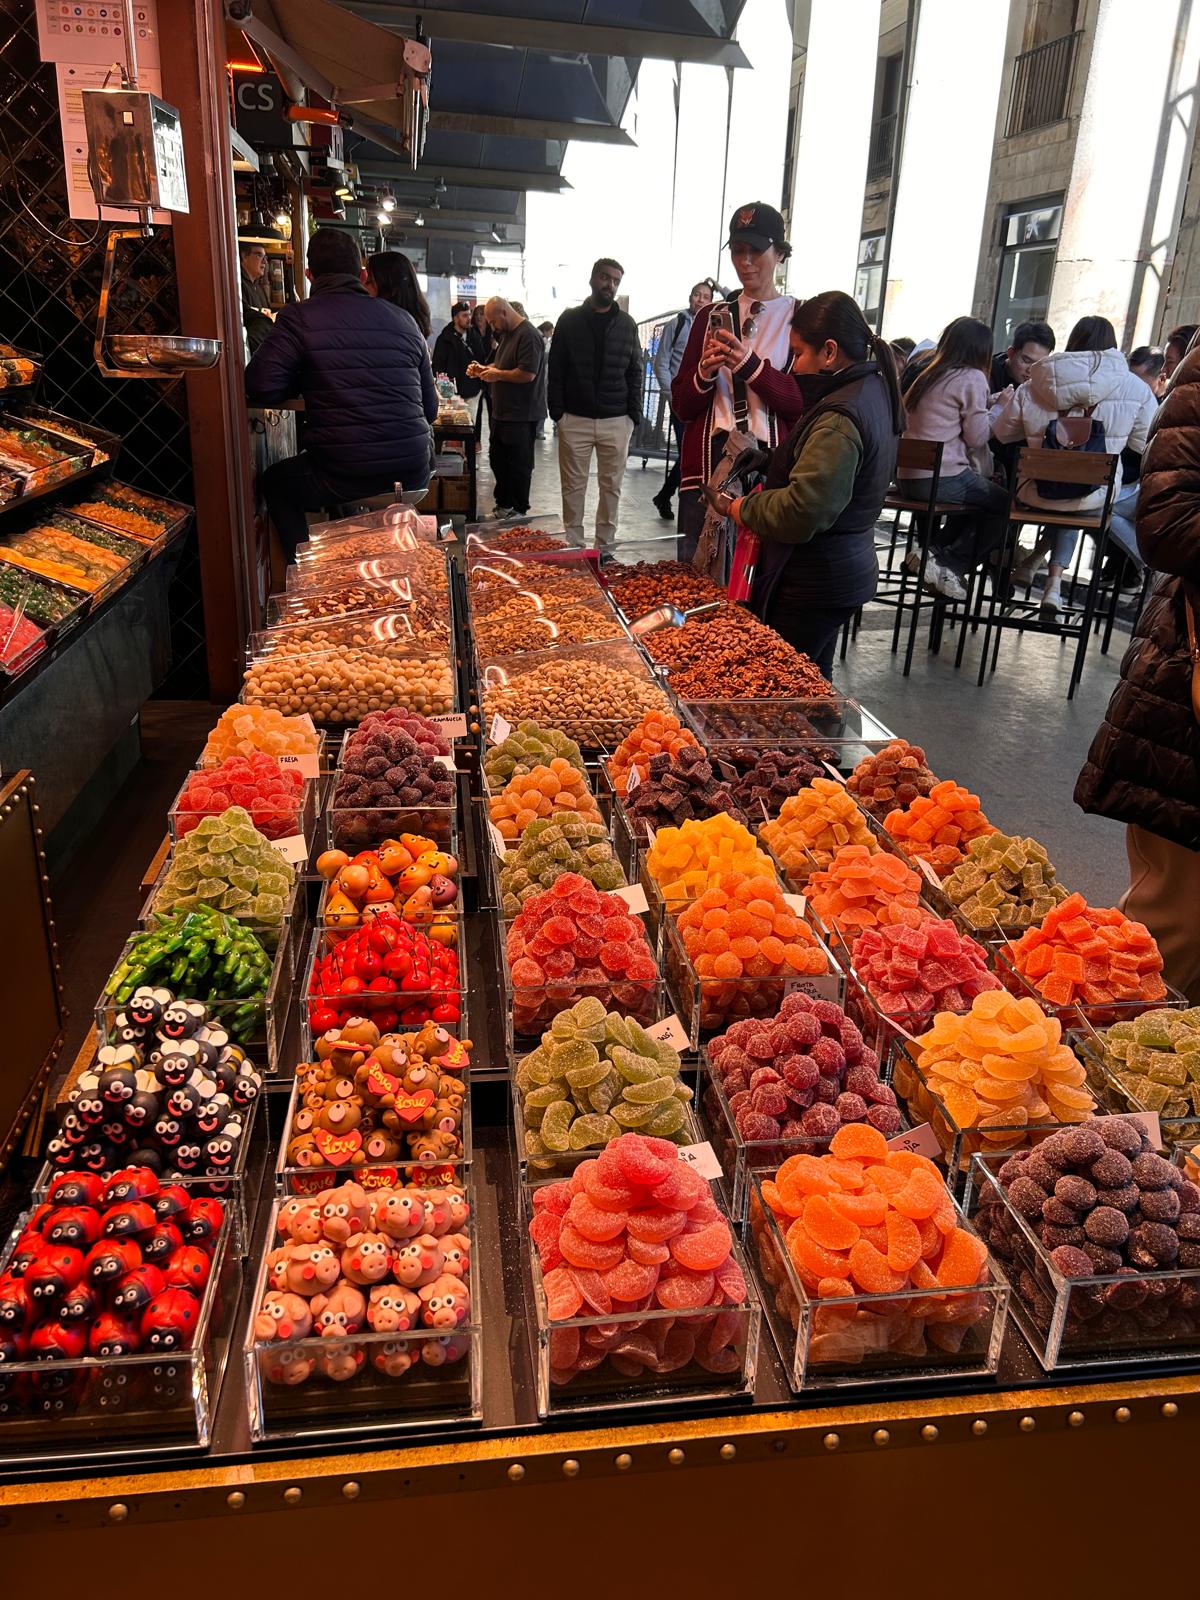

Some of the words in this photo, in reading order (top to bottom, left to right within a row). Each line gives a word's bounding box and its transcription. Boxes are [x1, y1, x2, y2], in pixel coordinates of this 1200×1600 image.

[280, 756, 299, 764] FRESA
[395, 1095, 426, 1110] Love
[321, 1134, 357, 1155] Love
[359, 1168, 392, 1188] Love
